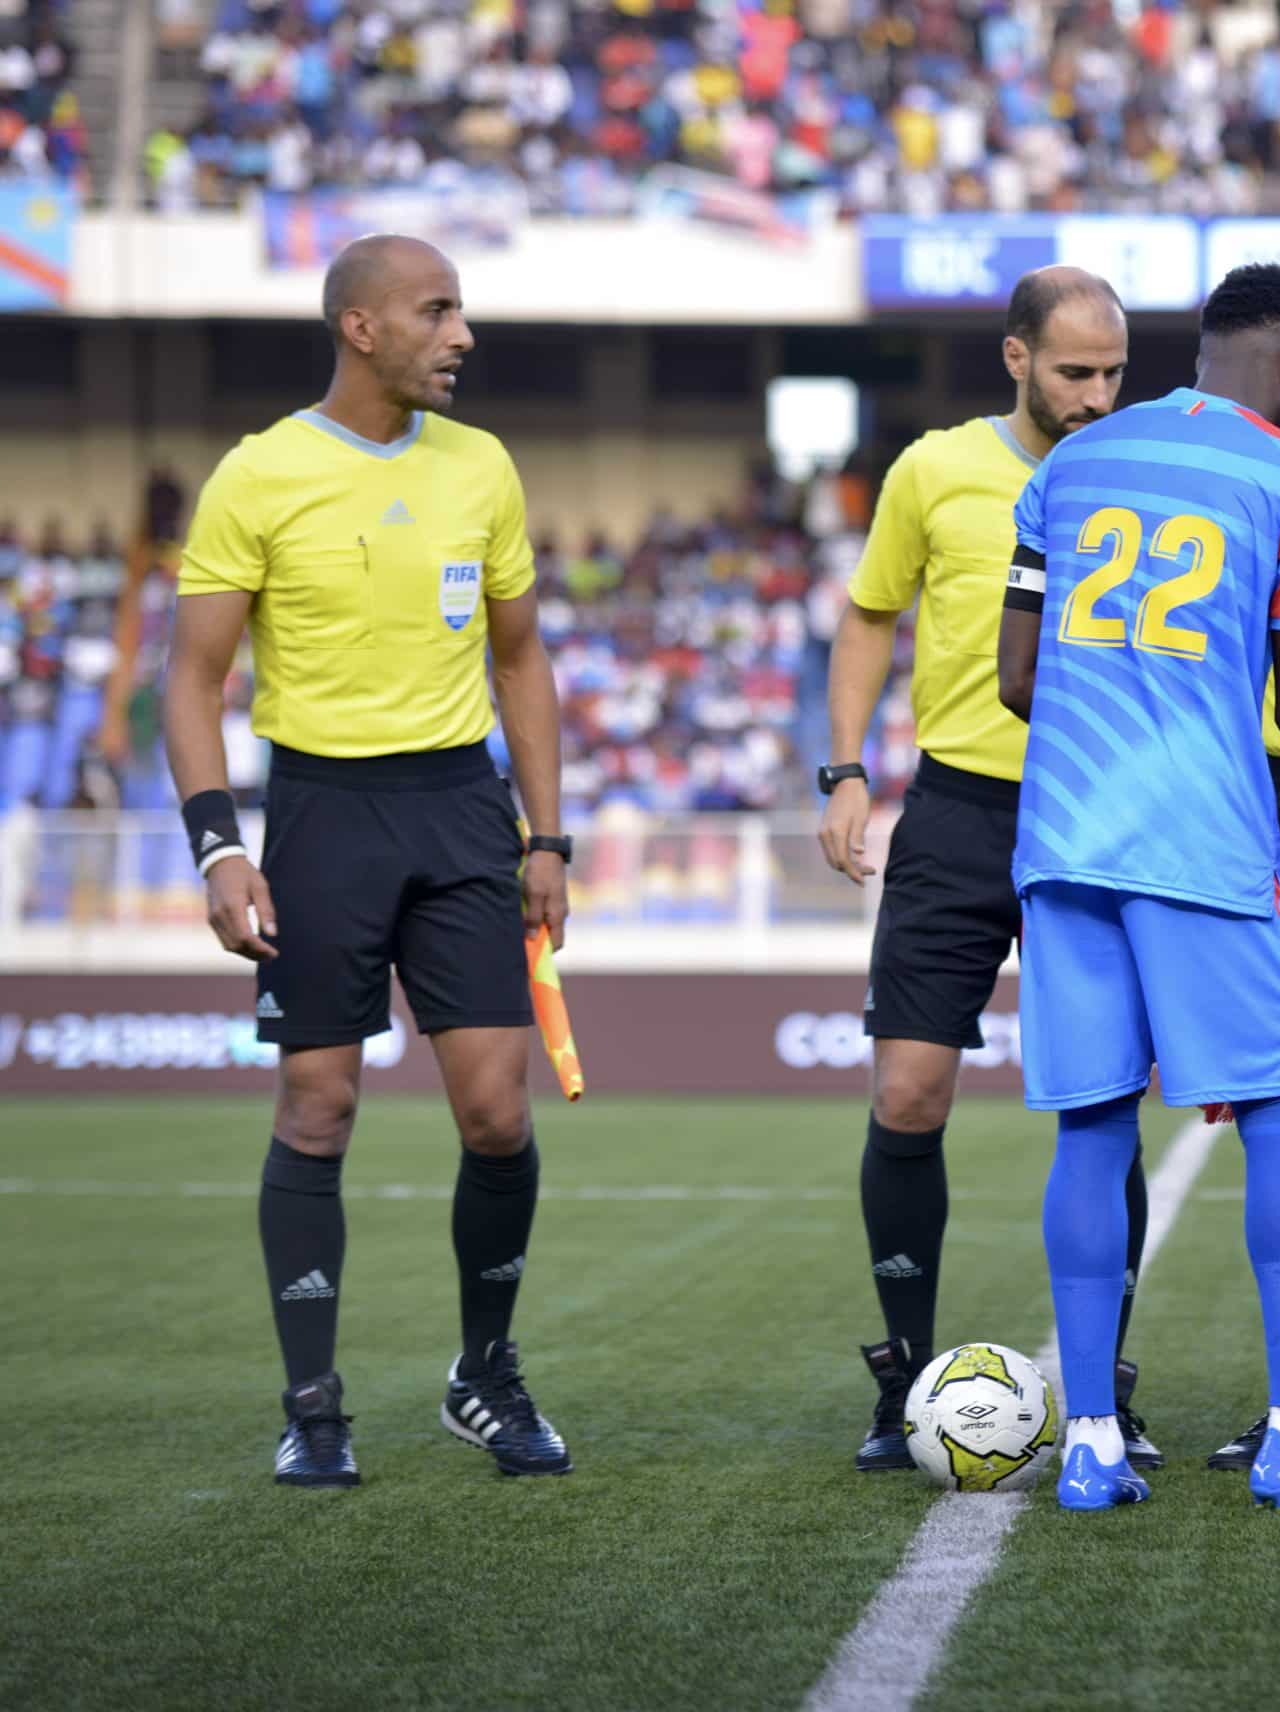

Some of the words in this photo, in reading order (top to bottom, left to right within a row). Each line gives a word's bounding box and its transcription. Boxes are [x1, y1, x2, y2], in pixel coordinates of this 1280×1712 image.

[444, 566, 477, 583] FIFA
[1057, 506, 1226, 662] 22
[960, 1421, 995, 1431] umbro
